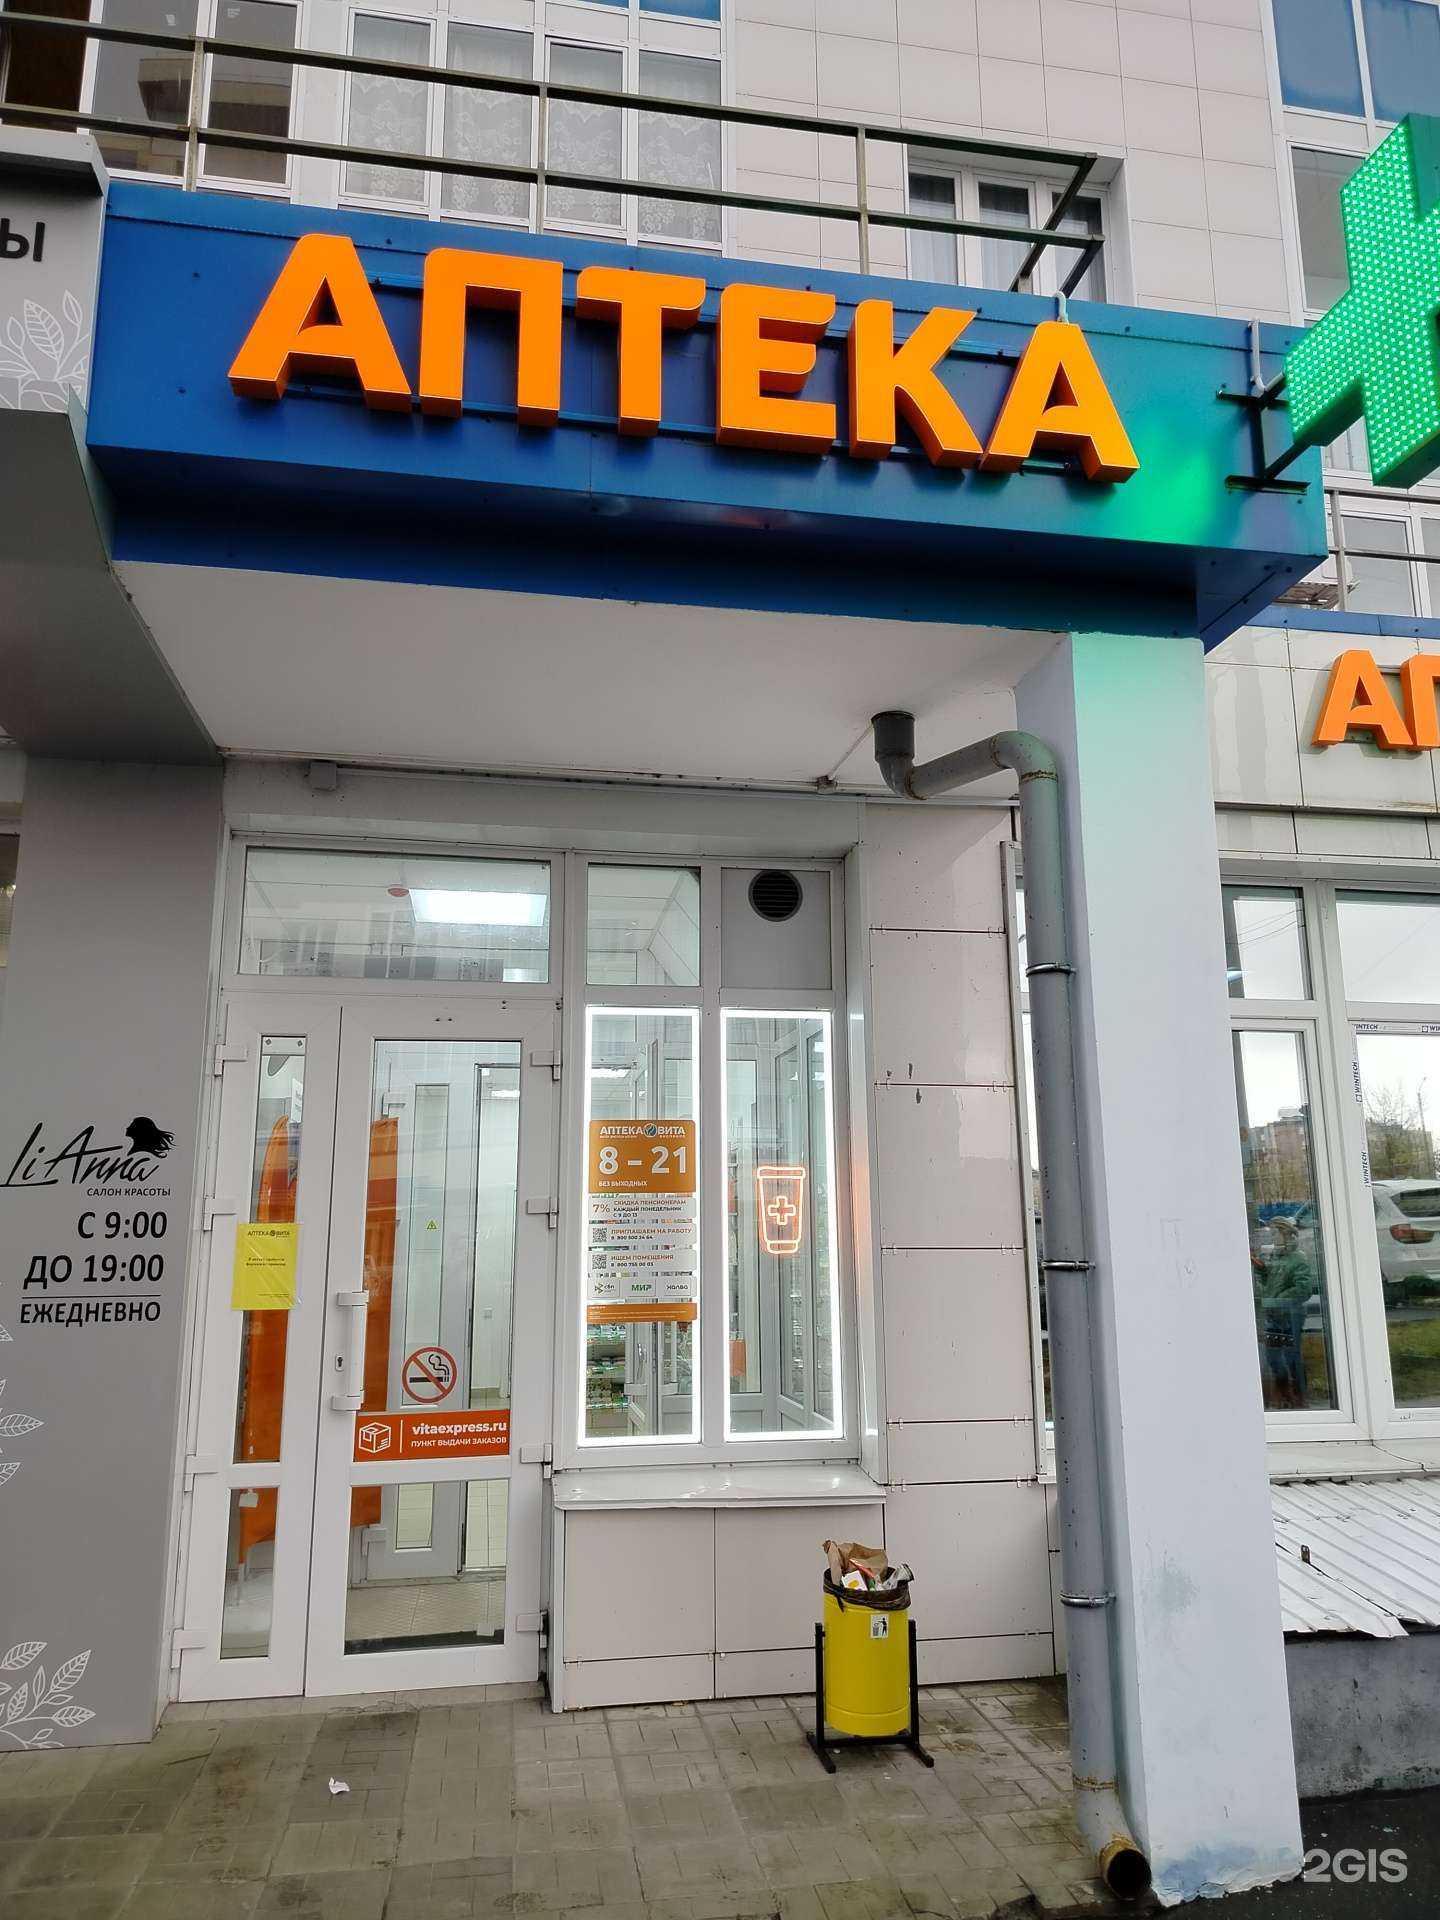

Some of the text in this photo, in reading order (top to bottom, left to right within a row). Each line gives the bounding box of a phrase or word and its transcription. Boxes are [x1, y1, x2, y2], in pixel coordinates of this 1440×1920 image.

[228, 233, 1140, 482] АПТЕКА
[1352, 1061, 1360, 1093] WINTECH
[599, 1126, 686, 1135] АПТЕКА ВИТА
[599, 1146, 619, 1175] 8
[651, 1145, 687, 1174] 21
[1361, 1151, 1369, 1184] WINTECH
[86, 1187, 171, 1197] САЛОН КРАСОТЫ
[592, 1203, 610, 1213] 7%
[77, 1211, 168, 1239] С 9:00
[22, 1253, 165, 1290] ДО 19:00
[631, 1284, 652, 1292] МИР
[20, 1301, 161, 1328] ЕЖЕДНЕВНО
[411, 1436, 507, 1448] ПУНКТ ВЫДАЧИ ЗАКАЗОВ
[412, 1422, 507, 1435] vitaexpress.ru
